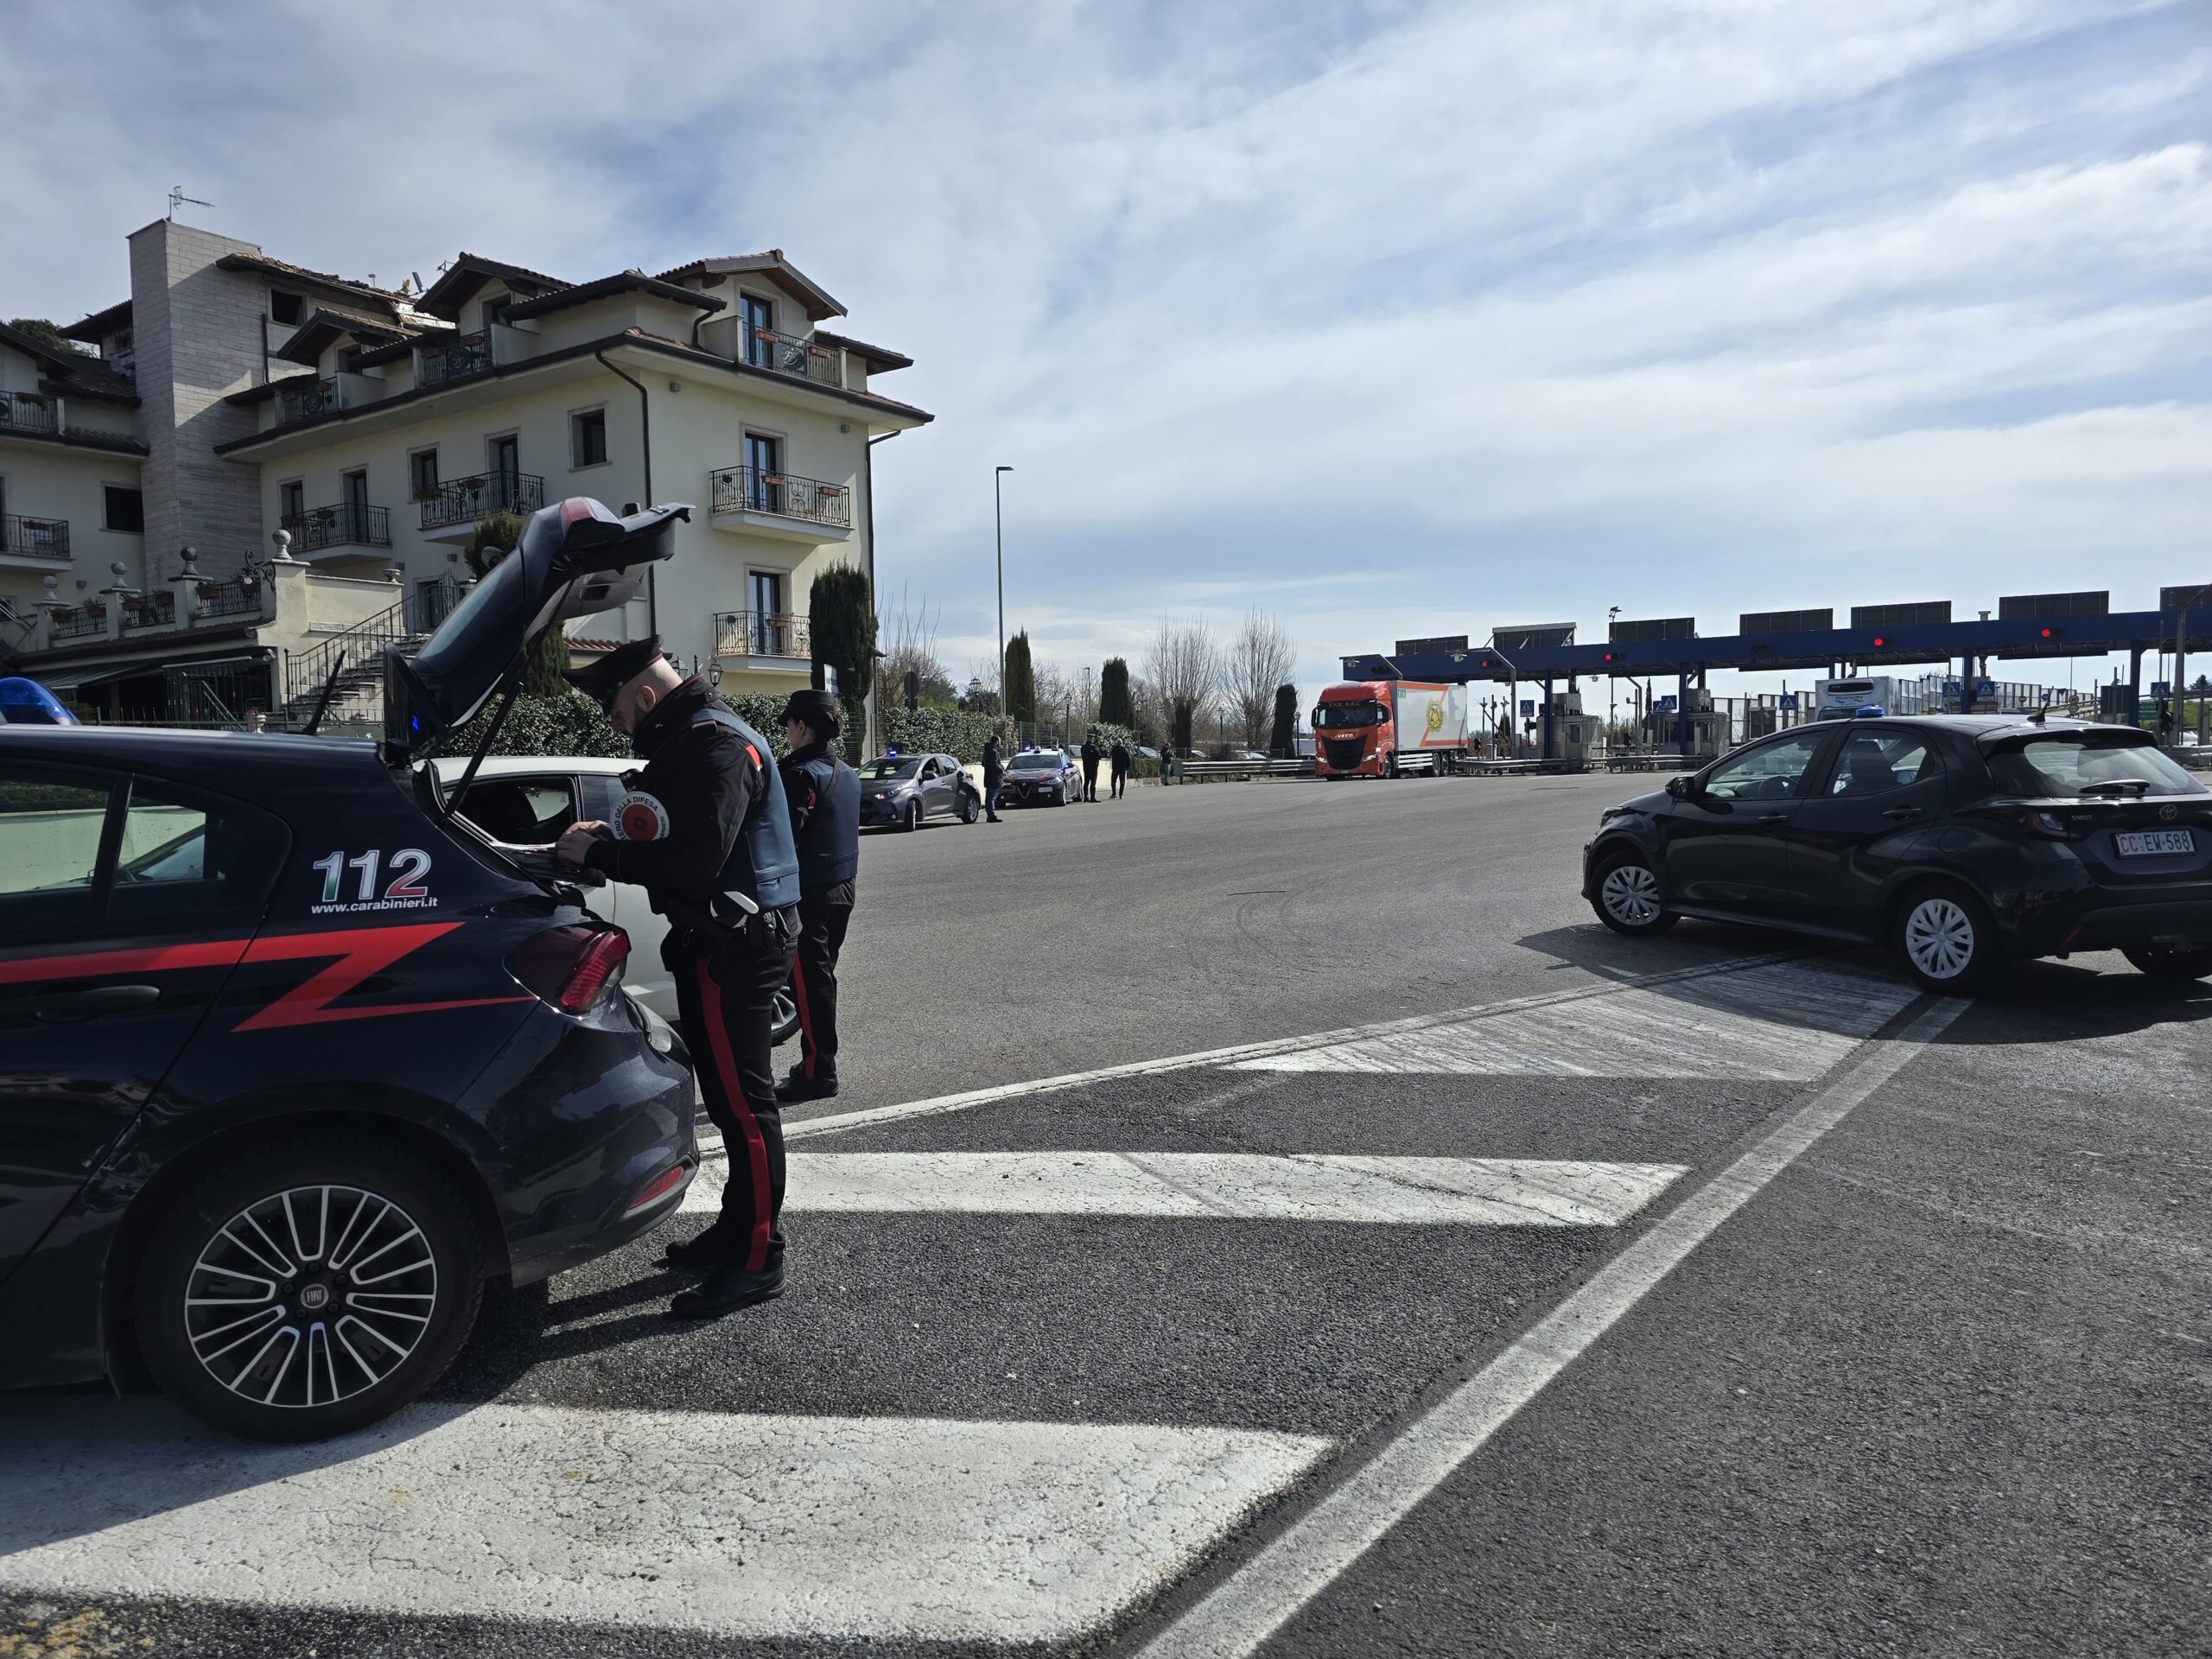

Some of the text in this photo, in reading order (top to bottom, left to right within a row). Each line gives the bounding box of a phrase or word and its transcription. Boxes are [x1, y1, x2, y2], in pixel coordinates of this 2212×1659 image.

[615, 798, 632, 818] DELLA
[632, 796, 658, 811] DIFESA
[2120, 836, 2139, 853] CC
[313, 848, 432, 903] 112
[311, 897, 439, 914] www.carabinieri.it
[306, 1289, 323, 1303] FIAT
